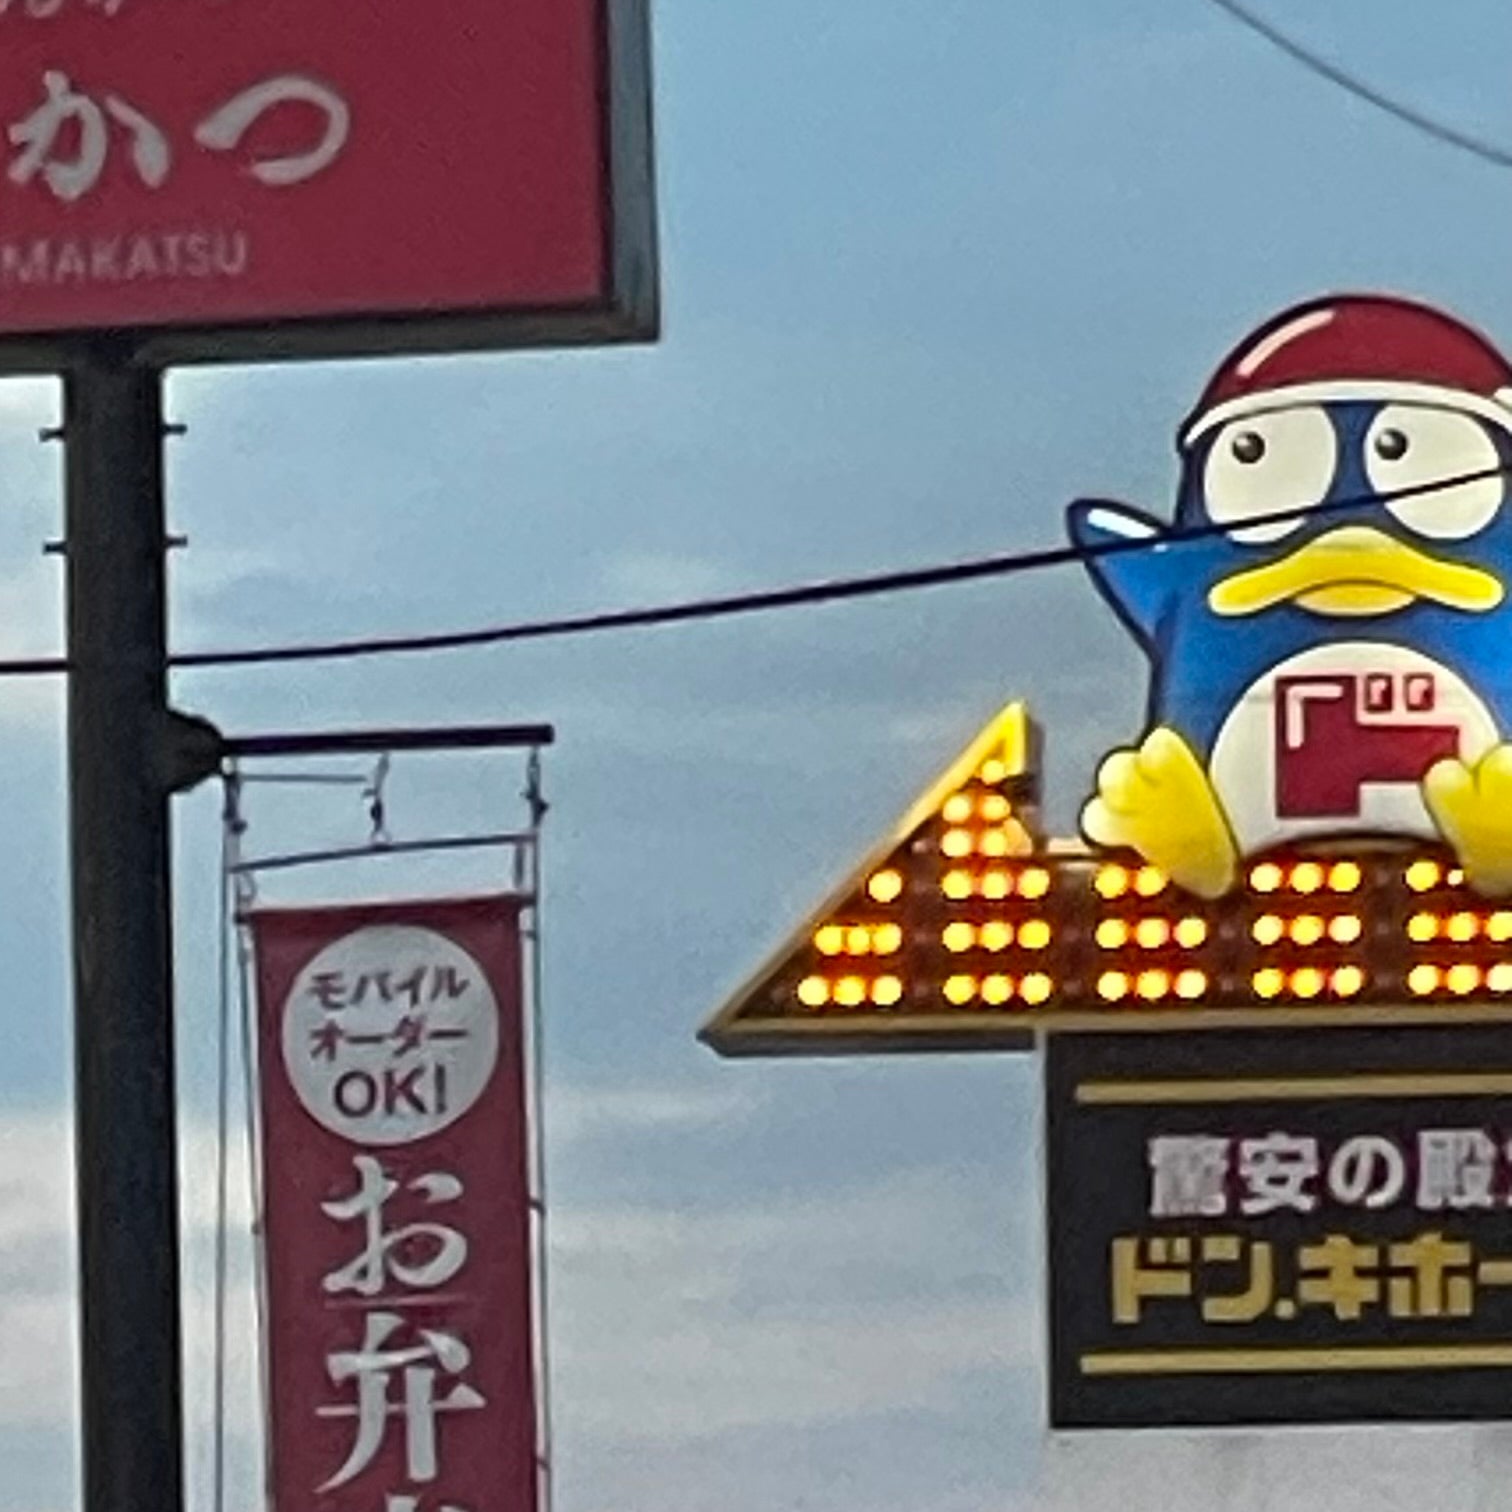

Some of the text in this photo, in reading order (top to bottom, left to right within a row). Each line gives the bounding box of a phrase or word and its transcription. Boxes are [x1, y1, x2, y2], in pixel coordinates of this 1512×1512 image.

[307, 964, 471, 1011] モバイル
[310, 1015, 468, 1063] オーダー
[333, 1065, 448, 1119] OK!
[1148, 1129, 1512, 1218] 驚安の殿
[314, 1154, 487, 1512] お弁
